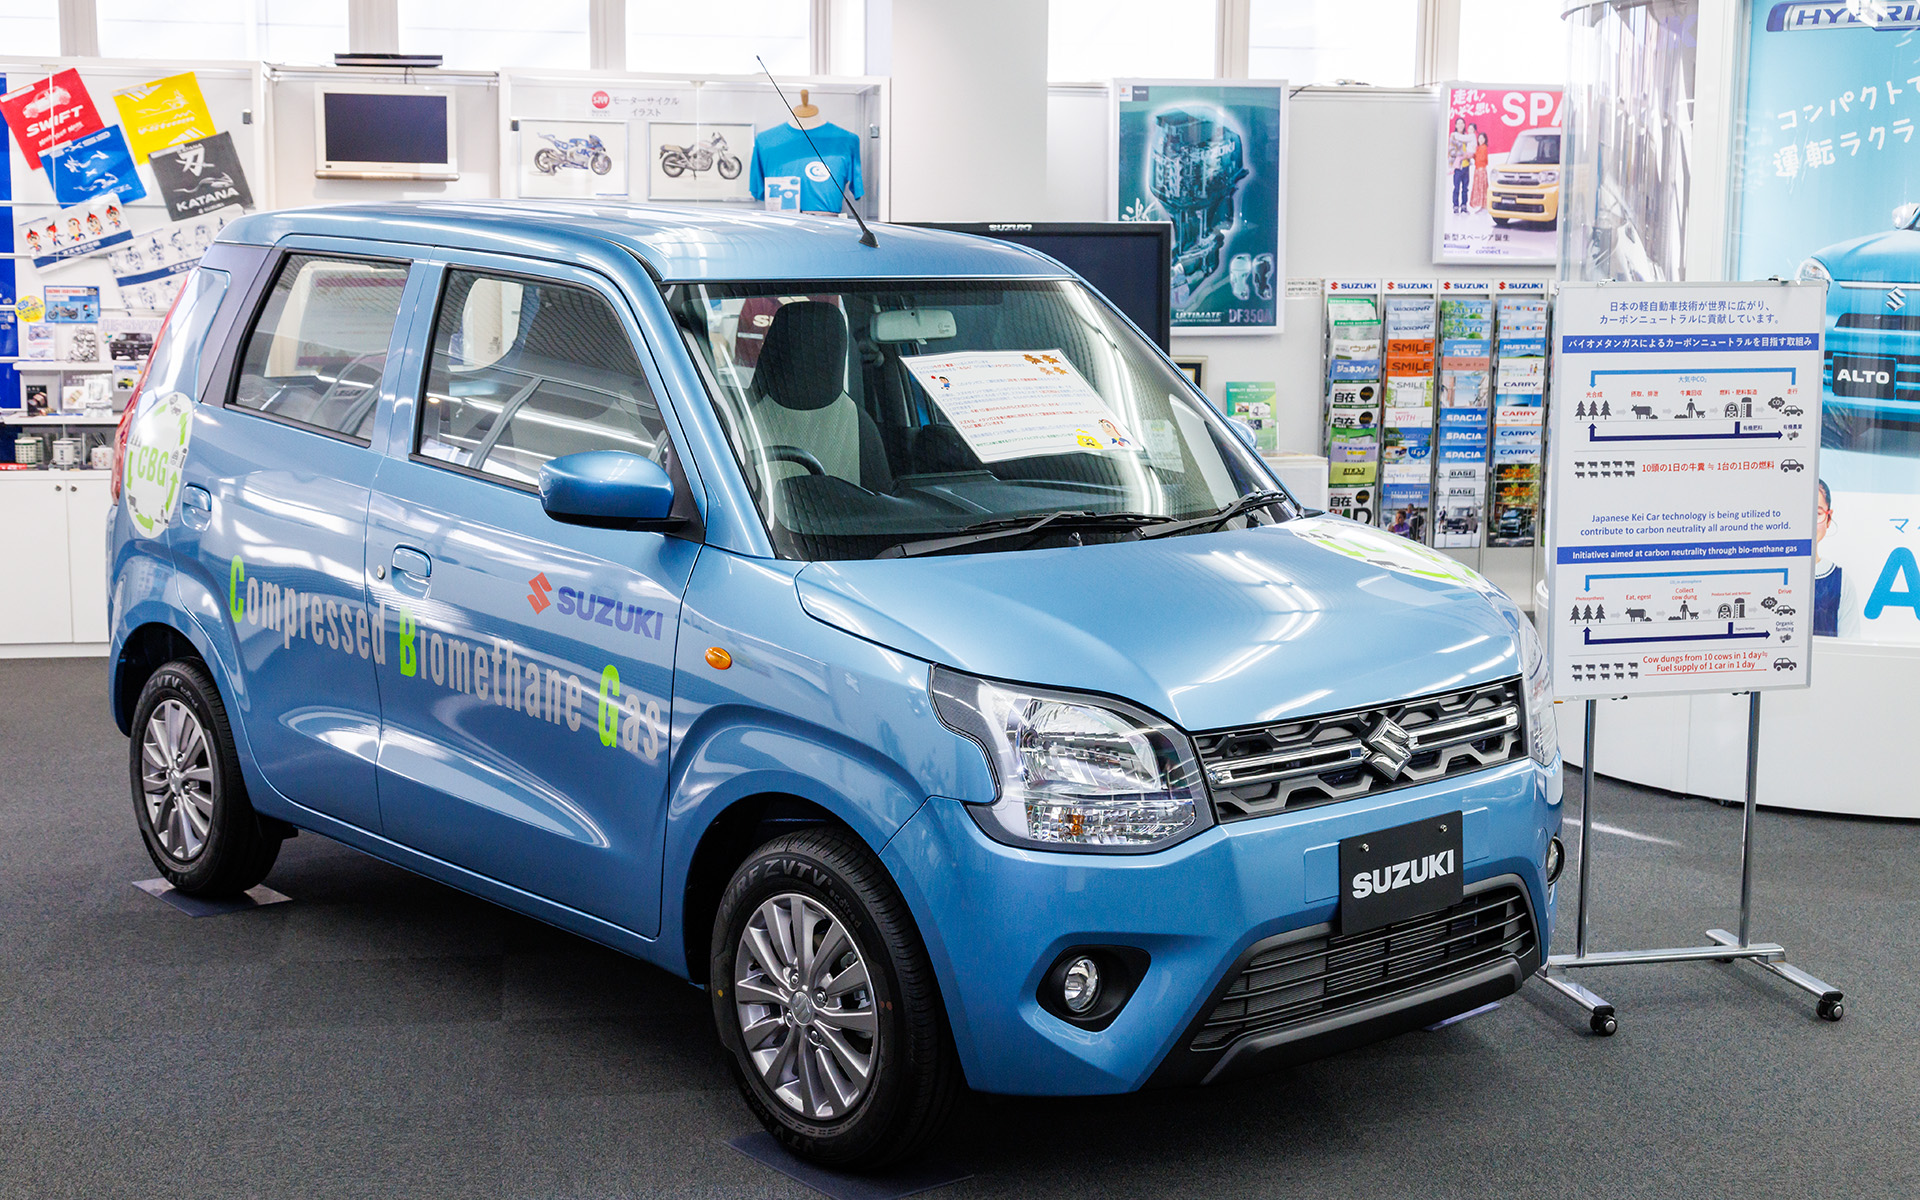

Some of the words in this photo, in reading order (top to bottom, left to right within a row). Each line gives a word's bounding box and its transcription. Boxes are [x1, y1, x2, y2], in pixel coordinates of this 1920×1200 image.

[1796, 4, 1920, 26] HYRI
[632, 108, 661, 116] イラスト
[26, 105, 84, 138] SWIFT
[176, 187, 240, 212] KATANA
[988, 224, 1032, 232] SUZUKI
[1340, 282, 1376, 290] SUZUKI
[1397, 282, 1433, 290] SUZUKI
[1453, 282, 1489, 290] SUZUKI
[1508, 282, 1544, 290] SUZUKI
[1610, 301, 1771, 312] 日本の軽自動車技術が世界に広がり、
[1228, 308, 1273, 323] DF350A
[1600, 314, 1779, 325] カーボンニュートラルに貢献しています。
[1392, 343, 1431, 352] SMILE
[1568, 337, 1812, 349] バイオメタンガスによるカーボンニュートラルを目指す取組み
[1453, 348, 1482, 356] ALTO
[1392, 362, 1430, 371] SMILE
[1836, 368, 1890, 384] ALTO
[1334, 392, 1356, 403] 自在
[1446, 414, 1482, 422] SPACIA
[1446, 432, 1482, 440] SPACIA
[1445, 451, 1481, 459] SPACIA
[137, 446, 168, 488] CBG
[1330, 496, 1352, 507] 自在
[1592, 513, 1630, 524] Japanese
[1632, 513, 1644, 522] Kei
[1646, 513, 1660, 522] Car
[1662, 511, 1706, 523] technology
[1709, 511, 1715, 520] is
[1717, 510, 1739, 521] being
[1742, 510, 1770, 519] utilized
[1772, 510, 1781, 518] to
[1580, 525, 1623, 536] contribute
[1625, 526, 1634, 535] to
[1636, 524, 1664, 534] carbon
[1667, 523, 1706, 535] neutrality
[1708, 522, 1718, 532] all
[1720, 522, 1748, 531] around
[1750, 522, 1764, 531] the
[1766, 521, 1791, 530] world.
[1573, 550, 1609, 559] Initiatives
[1610, 549, 1633, 558] aimed
[1644, 548, 1669, 557] carbon
[1671, 548, 1707, 558] neutrality
[1708, 546, 1737, 557] through
[1738, 544, 1784, 554] bio-methane
[1785, 546, 1797, 554] gas
[557, 586, 664, 642] SUZUKI
[230, 555, 386, 666] Compressed
[399, 606, 582, 732] Biomethane
[597, 664, 659, 760] Gas
[1643, 656, 1661, 664] Cow
[1663, 654, 1682, 665] dungs
[1684, 653, 1702, 662] from
[1714, 652, 1732, 660] cows
[1734, 652, 1740, 660] in
[1748, 652, 1762, 660] day
[1656, 664, 1670, 672] Fuel
[1673, 662, 1698, 673] supply
[1700, 662, 1707, 670] of
[1742, 660, 1755, 670] day
[1352, 849, 1454, 898] SUZUKI
